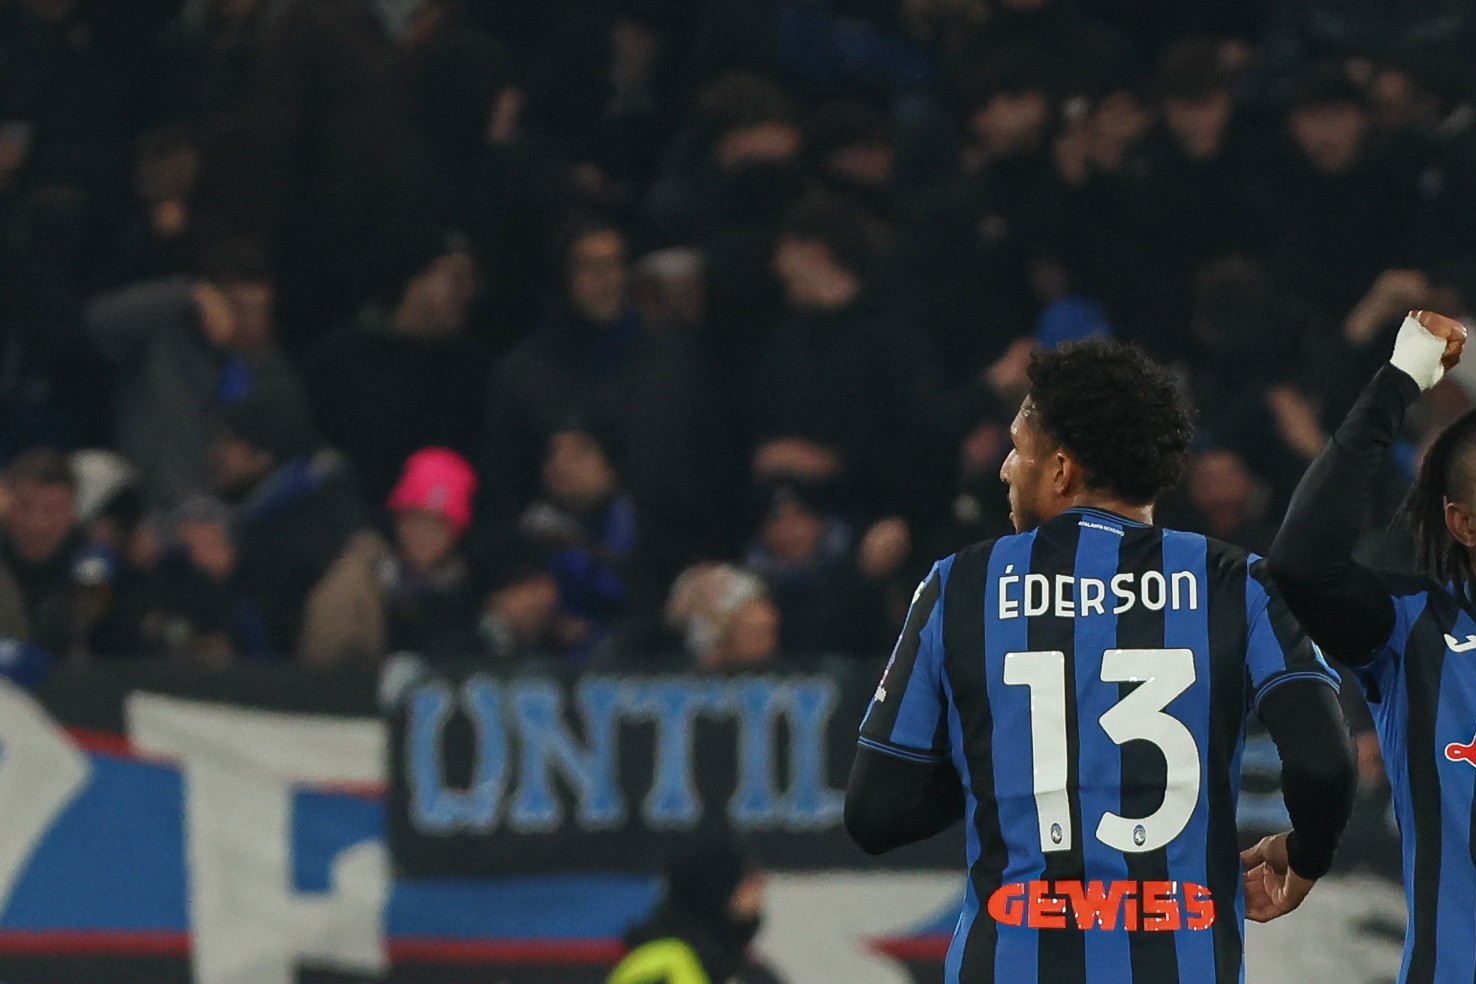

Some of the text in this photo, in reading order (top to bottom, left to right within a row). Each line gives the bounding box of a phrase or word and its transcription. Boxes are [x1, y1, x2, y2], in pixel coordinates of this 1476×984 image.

[998, 564, 1198, 620] ÉDERSON
[408, 672, 848, 836] UNTIL
[1002, 648, 1201, 853] 13
